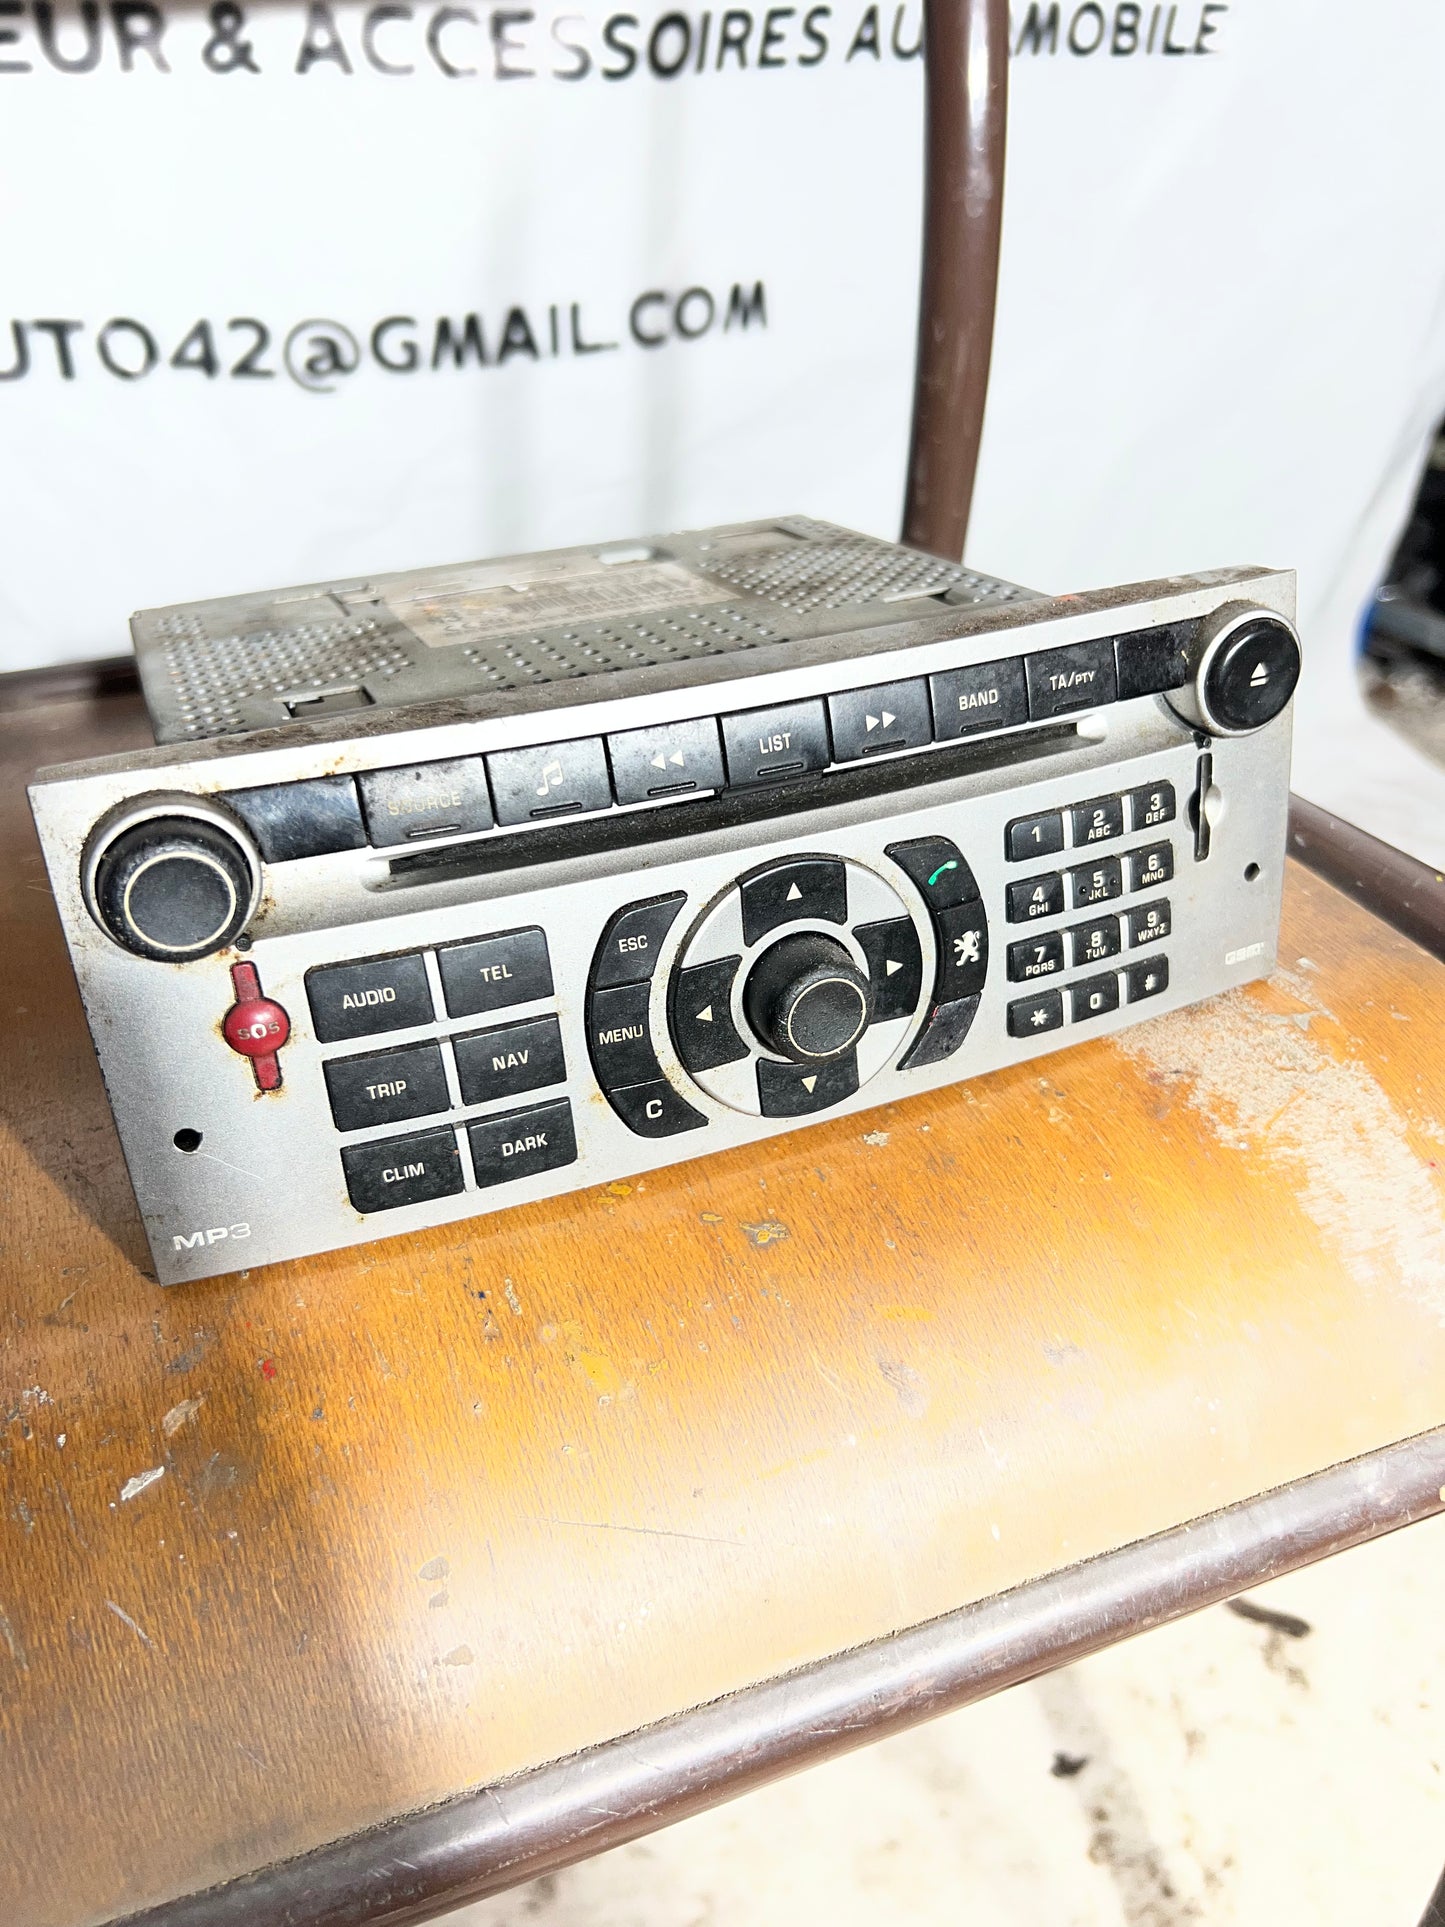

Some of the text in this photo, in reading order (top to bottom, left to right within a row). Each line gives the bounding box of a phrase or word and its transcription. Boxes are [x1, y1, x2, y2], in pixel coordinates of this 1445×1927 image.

[201, 2, 260, 73] &
[295, 4, 830, 81] ACCESSOIRES
[845, 2, 1228, 63] AUMOBILE
[1049, 670, 1095, 691] TA/PTY
[958, 689, 998, 711] BAND
[759, 733, 791, 754] LIST
[1150, 793, 1161, 811] 3
[1092, 809, 1104, 827] 2
[1145, 810, 1166, 825] DEF
[1031, 826, 1041, 843] 1
[1087, 826, 1111, 841] ABC
[1148, 854, 1158, 871] 6
[1092, 871, 1104, 888] 5
[1141, 868, 1164, 884] MNO
[1032, 886, 1045, 903] 4
[1088, 887, 1109, 901] JKL
[1028, 902, 1048, 916] GHI
[1146, 911, 1157, 928] 9
[1091, 930, 1102, 948] 8
[1137, 925, 1166, 943] WXYZ
[618, 934, 649, 954] ESC
[1086, 945, 1107, 960] TUV
[1034, 946, 1045, 963] 7
[480, 962, 513, 982] TEL
[1025, 960, 1055, 977] PQRS
[342, 987, 397, 1011] AUDIO
[237, 1021, 280, 1040] SOS
[598, 1024, 645, 1046] MENU
[492, 1049, 529, 1072] NAV
[366, 1079, 408, 1101] TRIP
[645, 1100, 663, 1119] C
[501, 1132, 549, 1157] DARK
[382, 1162, 426, 1184] CLIM
[172, 1222, 252, 1251] MP3
